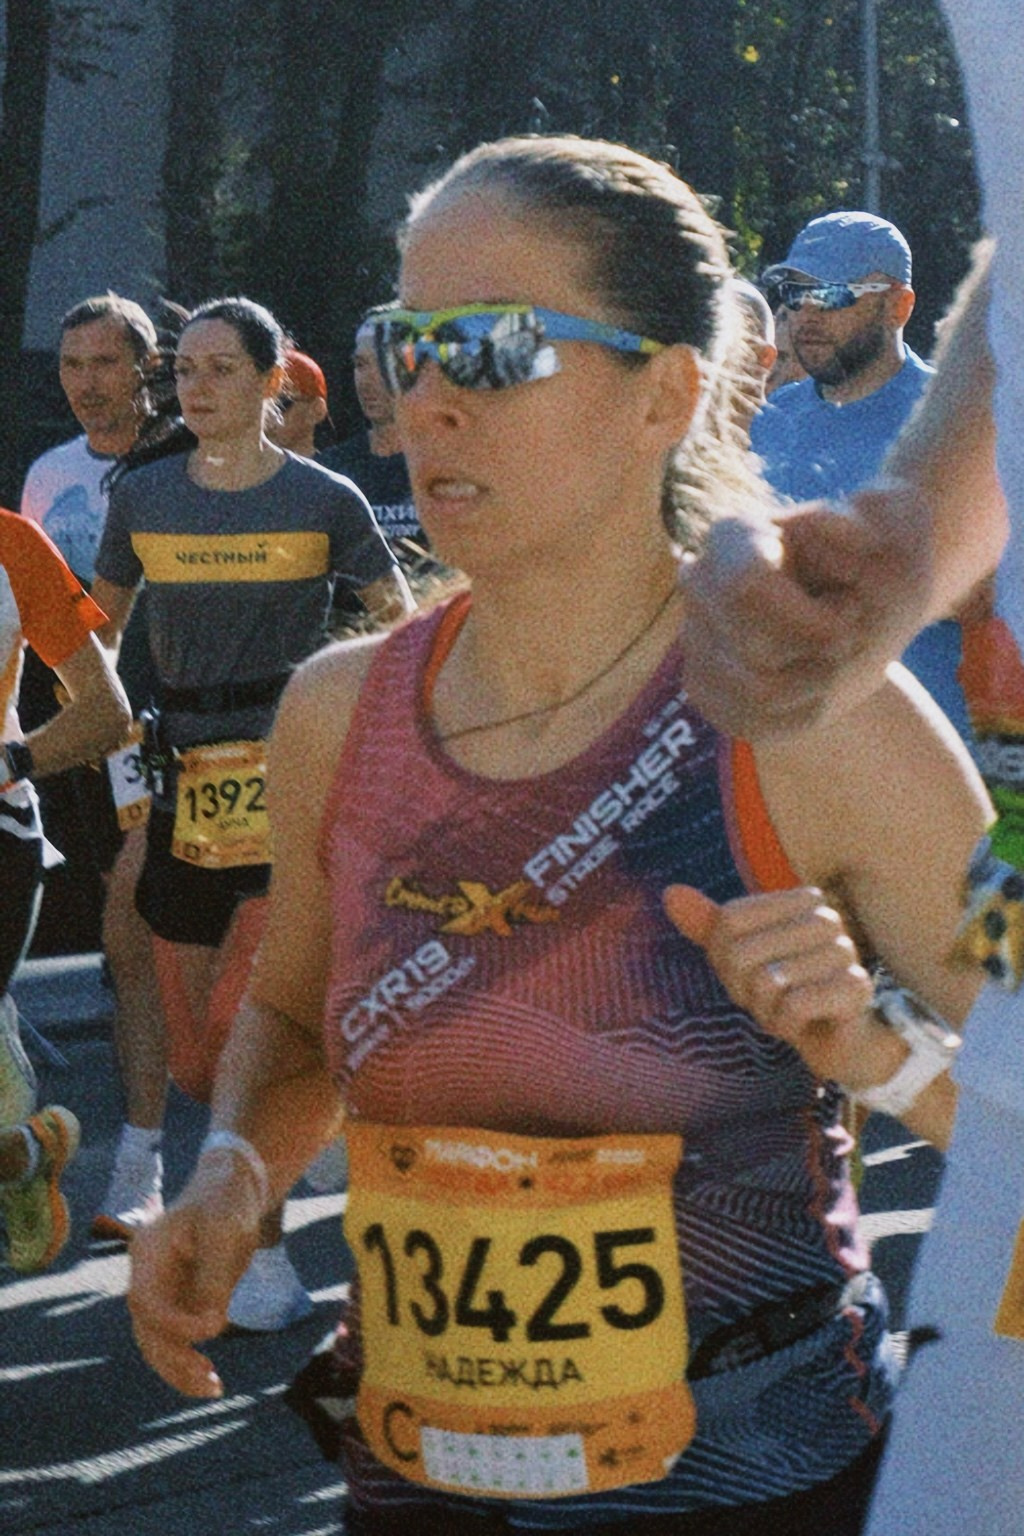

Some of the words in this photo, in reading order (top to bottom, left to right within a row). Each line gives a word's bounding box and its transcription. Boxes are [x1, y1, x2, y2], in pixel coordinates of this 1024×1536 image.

[176, 541, 268, 564] ЧЕСТНЫЙ
[524, 719, 697, 888] FINISHER
[620, 770, 681, 834] RACE
[341, 940, 450, 1043] CXR19
[362, 1222, 665, 1343] 13425
